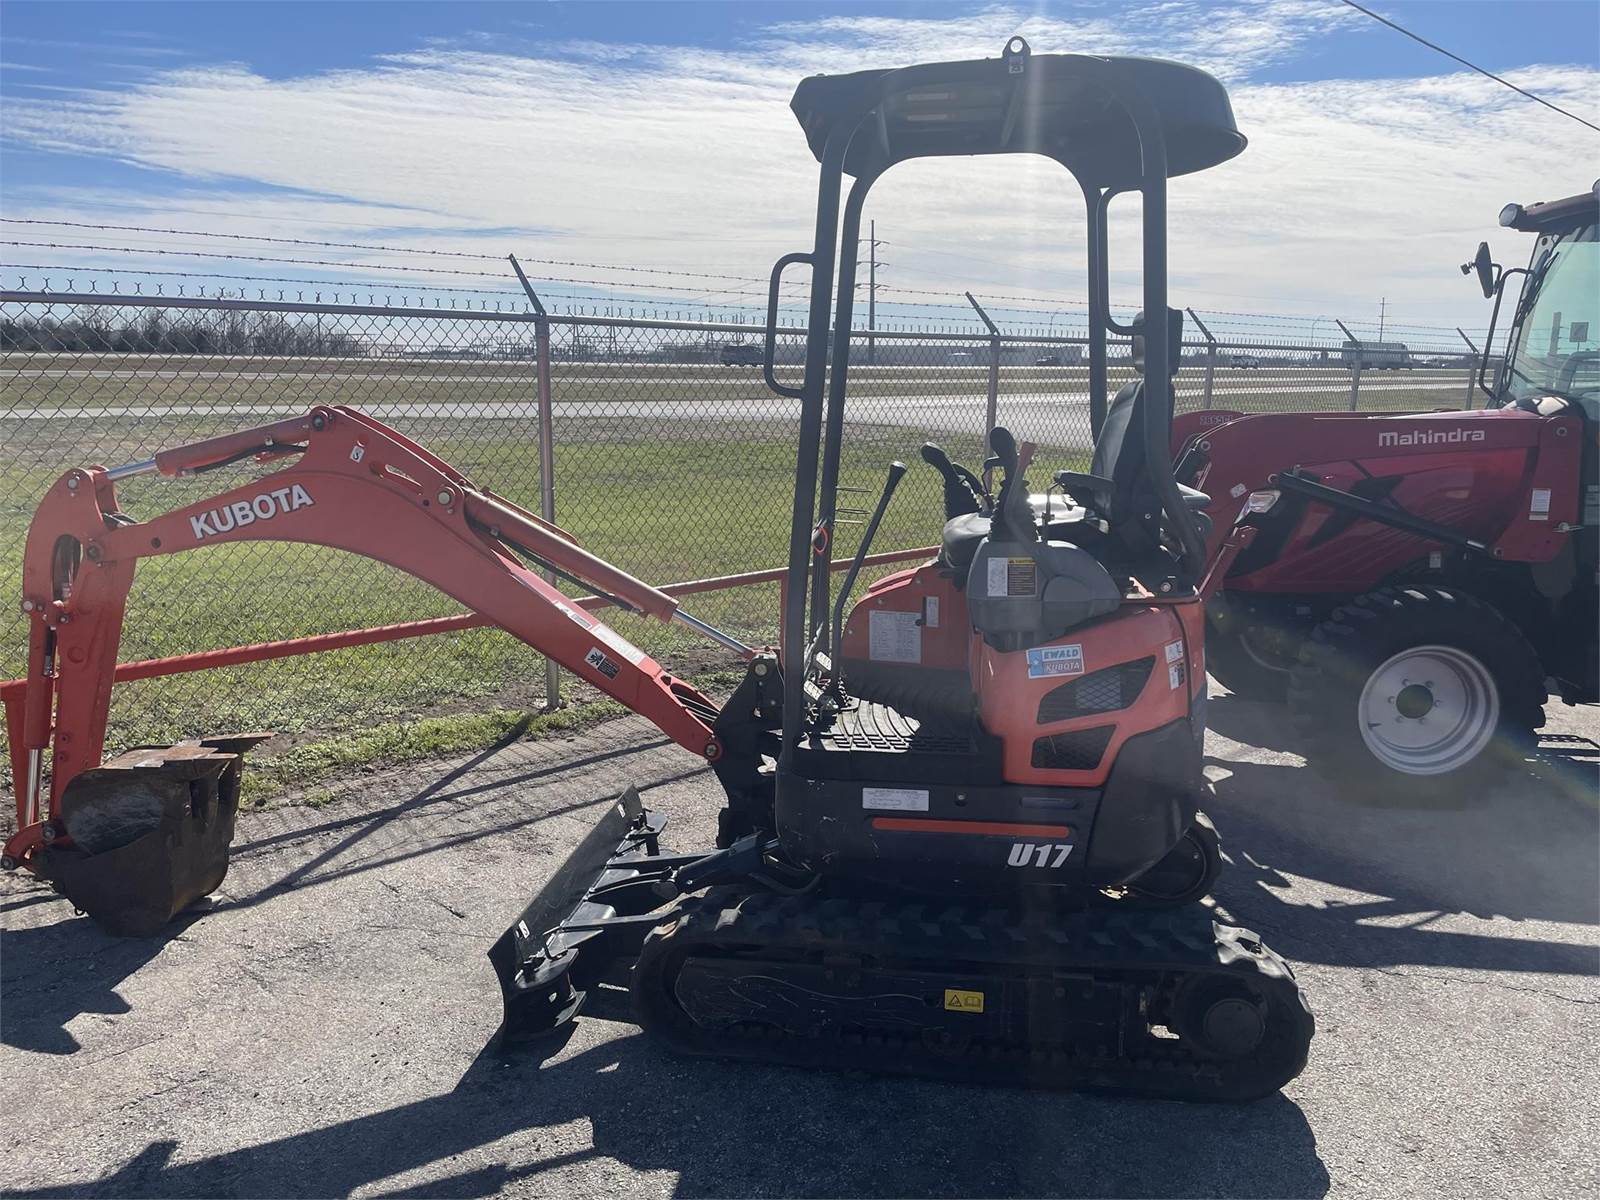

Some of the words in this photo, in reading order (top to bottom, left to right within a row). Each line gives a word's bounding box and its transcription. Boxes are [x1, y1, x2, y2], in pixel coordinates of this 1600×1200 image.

[1379, 428, 1485, 447] Mahindra
[190, 484, 314, 539] KUBOTA
[1044, 649, 1079, 660] EWALD
[1046, 662, 1080, 671] KUBOTA
[1007, 843, 1073, 867] U17
